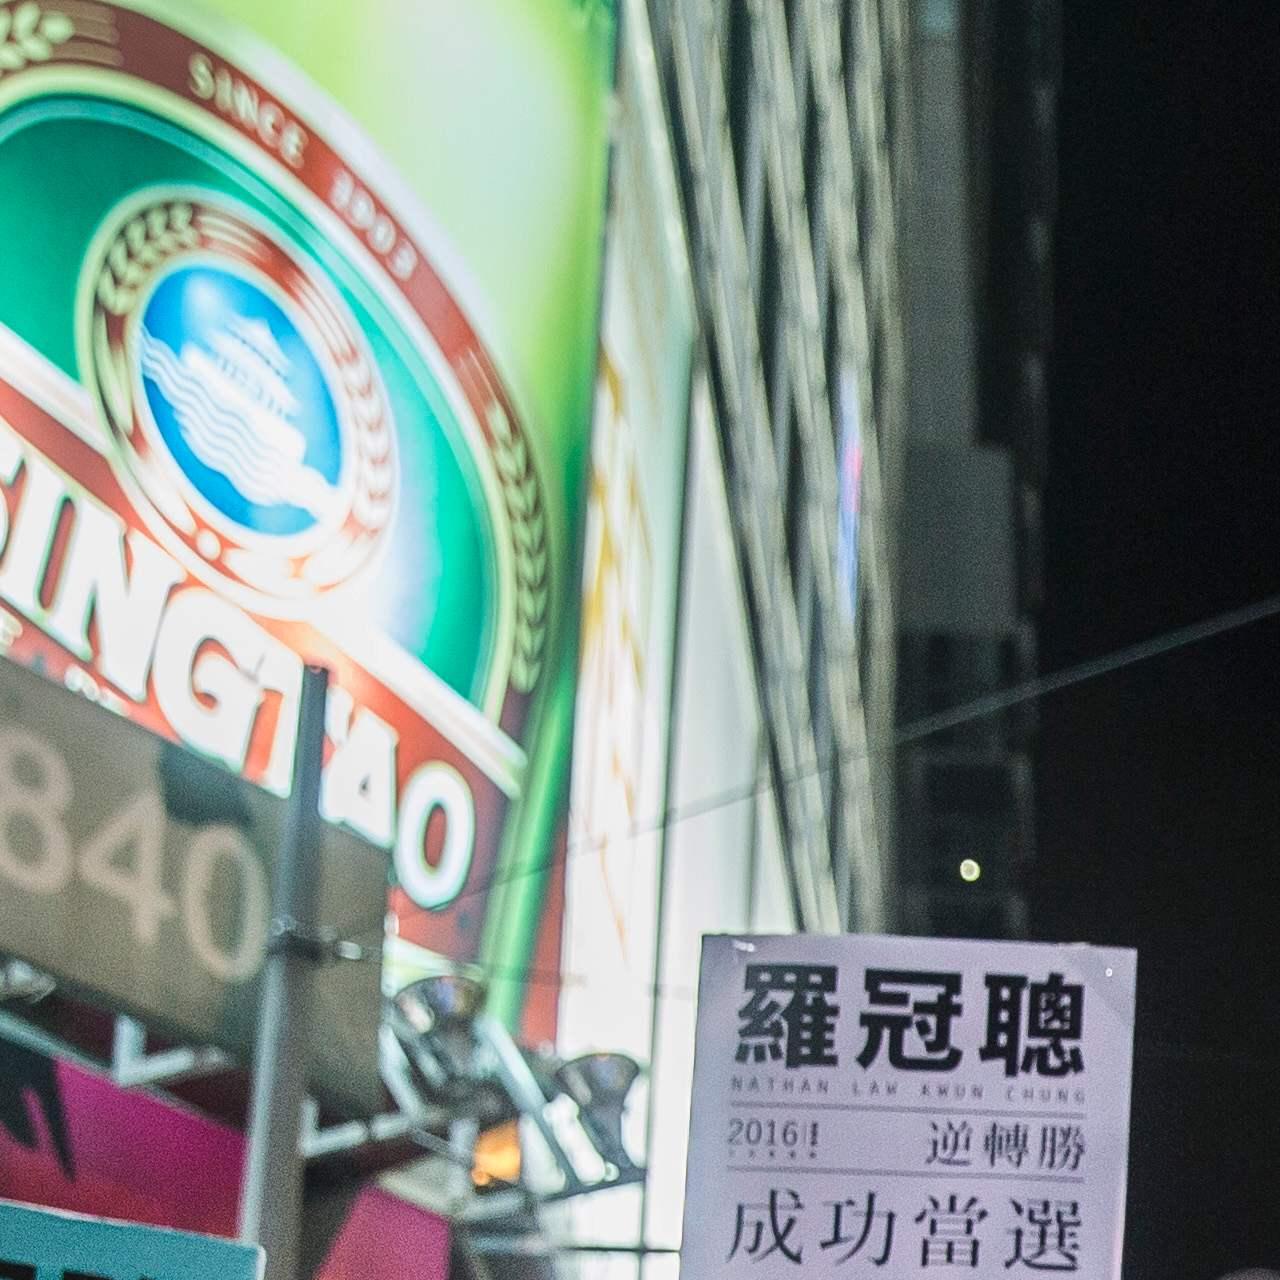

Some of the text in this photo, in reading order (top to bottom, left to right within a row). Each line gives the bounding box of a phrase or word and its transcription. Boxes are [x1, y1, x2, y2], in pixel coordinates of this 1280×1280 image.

[188, 53, 308, 169] SINCE
[0, 430, 477, 908] INGTAO
[734, 963, 1086, 1078] 羅冠聰
[731, 1076, 830, 1095] NATHAN
[727, 1118, 799, 1147] 2016
[923, 1120, 1086, 1171] 逆轉勝
[725, 1187, 1082, 1273] 成功當選
